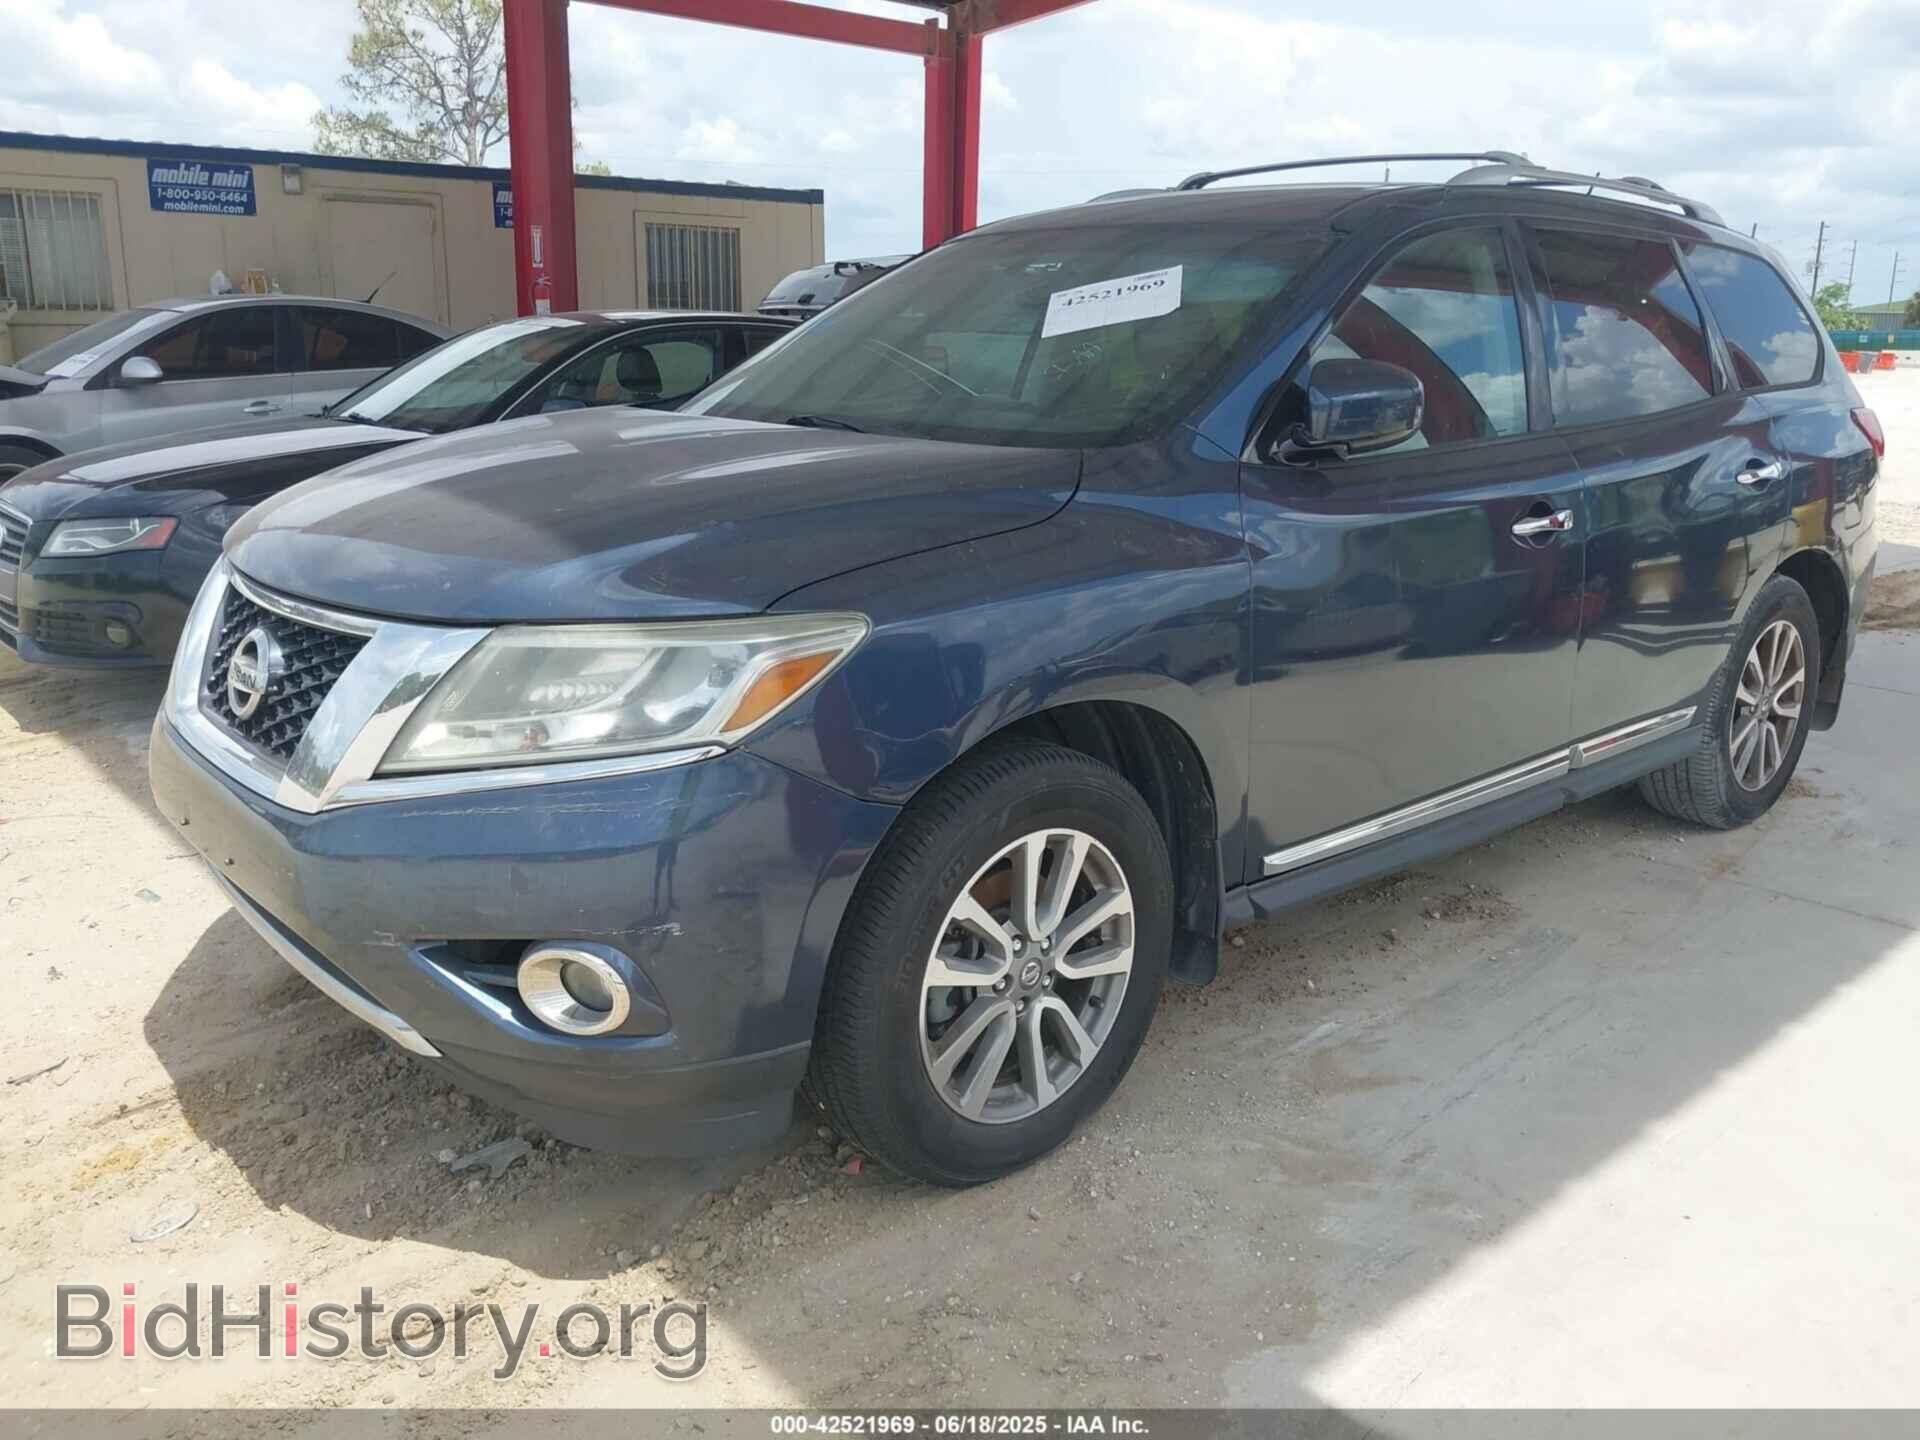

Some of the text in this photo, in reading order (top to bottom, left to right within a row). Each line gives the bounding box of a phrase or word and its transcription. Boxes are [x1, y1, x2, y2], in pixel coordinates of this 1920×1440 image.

[152, 162, 250, 188] mobile mini
[163, 200, 245, 214] mobilemini.com
[1061, 279, 1166, 307] 42521969
